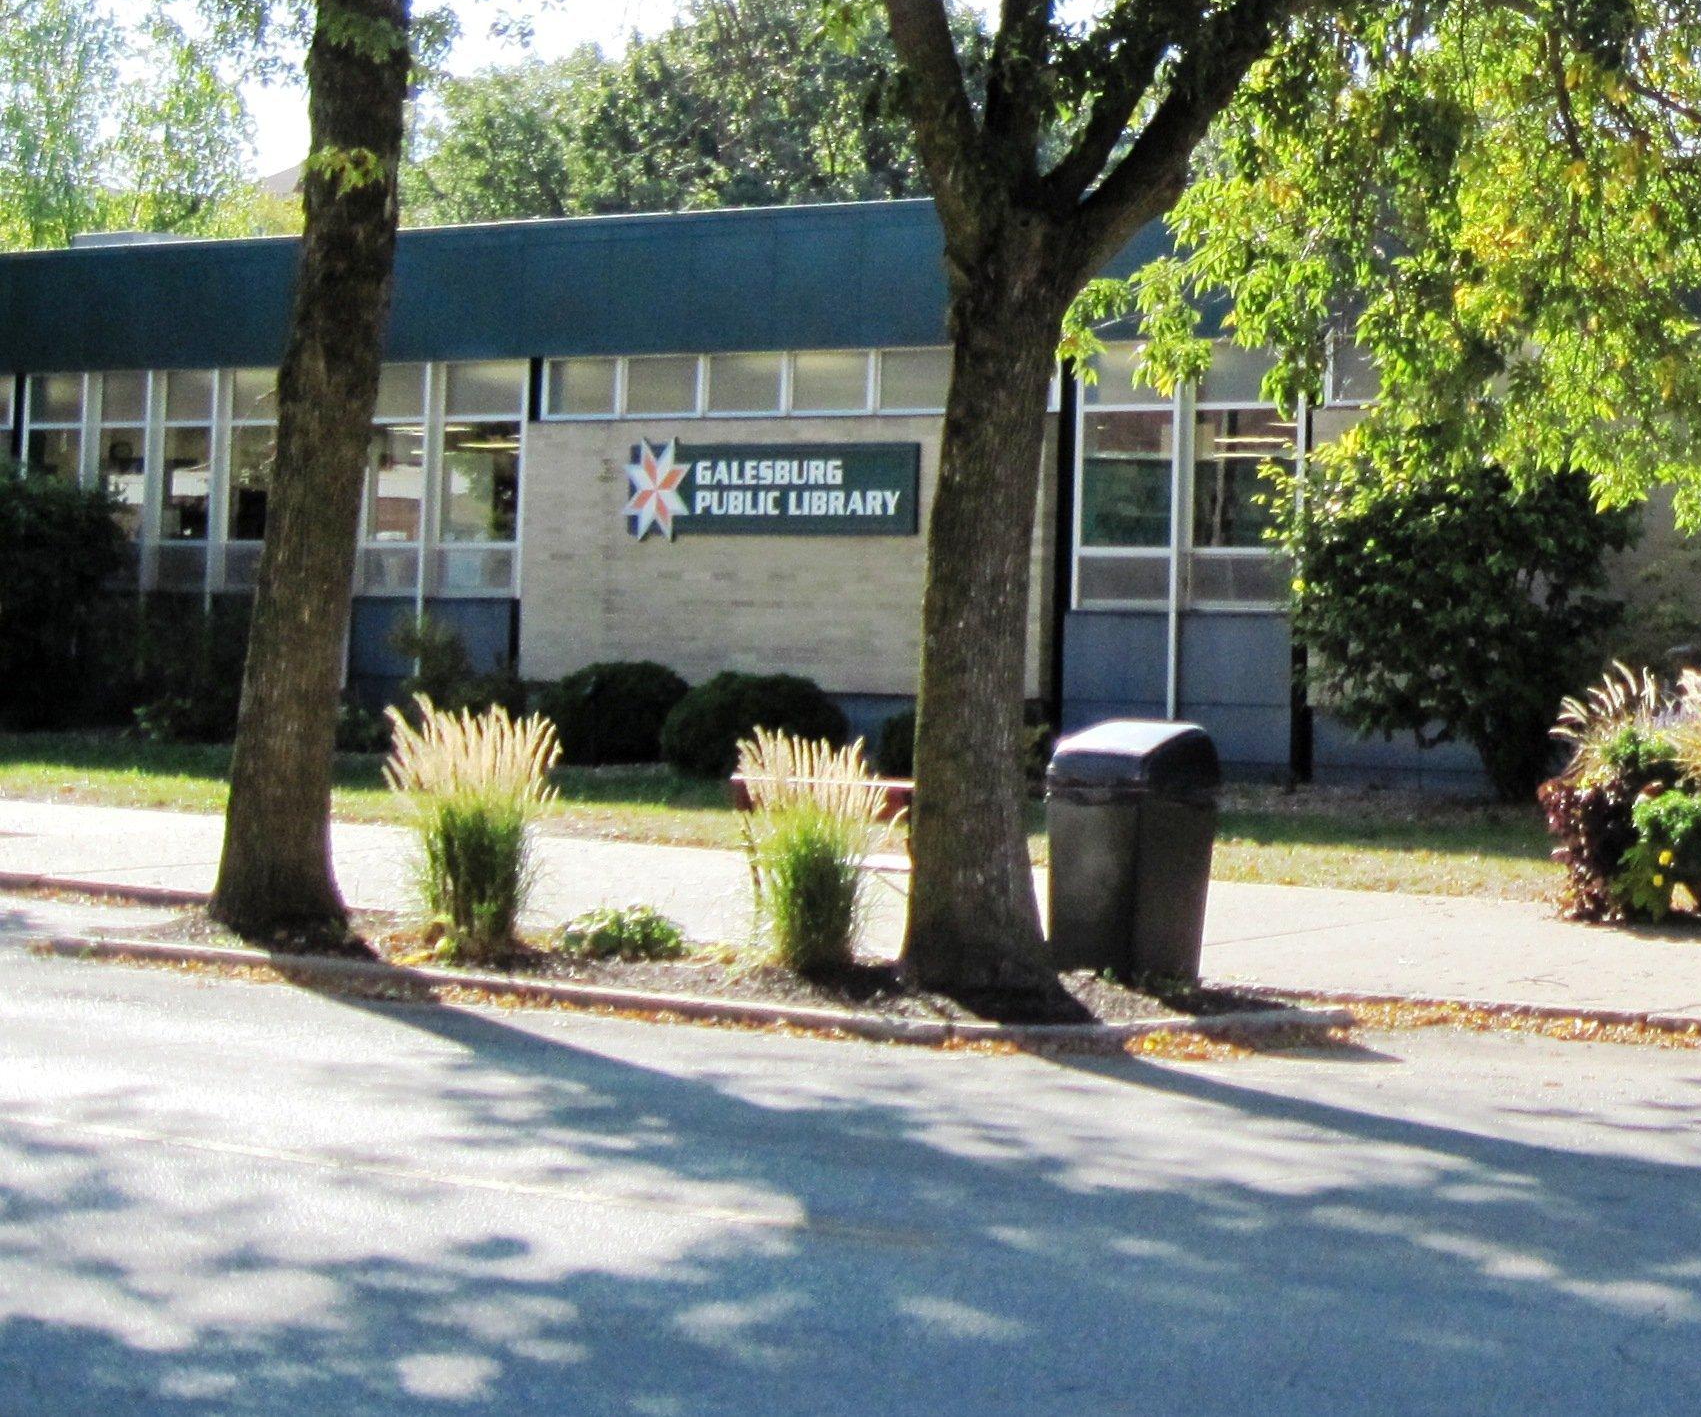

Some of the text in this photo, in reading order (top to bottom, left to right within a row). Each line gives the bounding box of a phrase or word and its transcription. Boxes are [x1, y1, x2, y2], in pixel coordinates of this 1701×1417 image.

[695, 460, 842, 485] GALESBURG
[695, 490, 900, 516] PUBLIC LIBRARY
